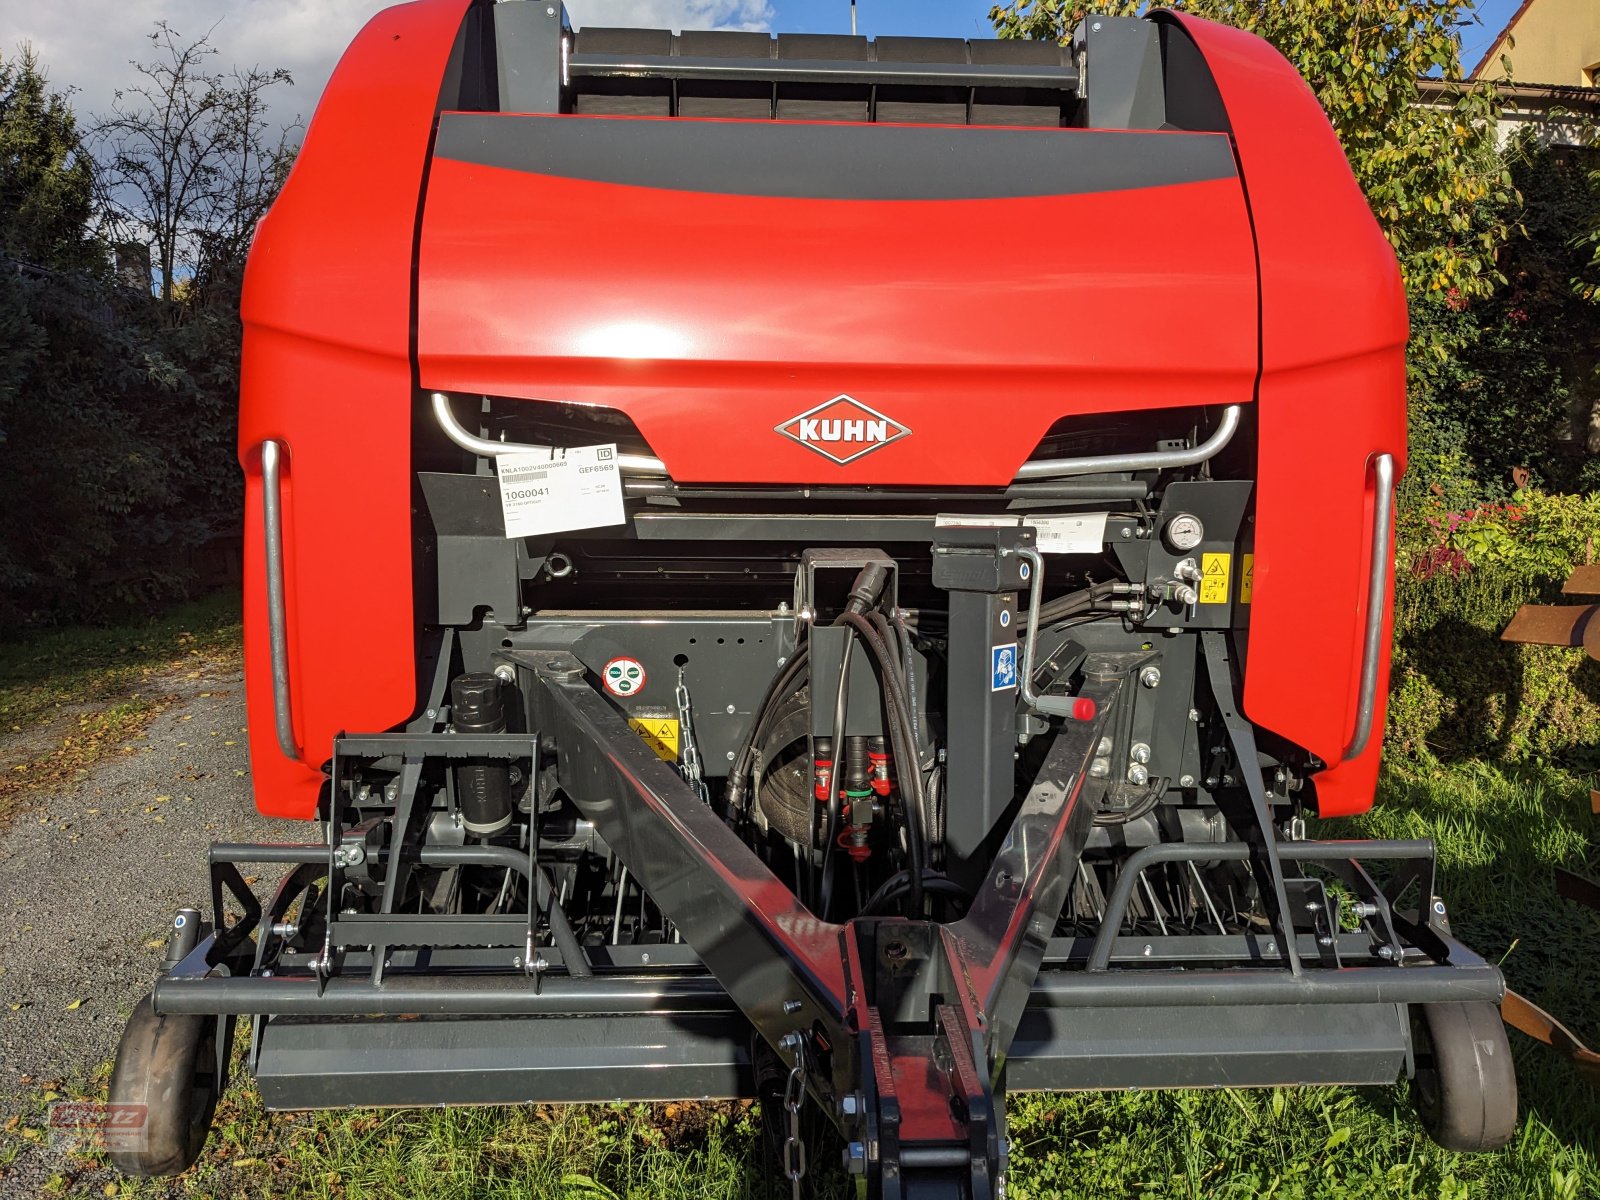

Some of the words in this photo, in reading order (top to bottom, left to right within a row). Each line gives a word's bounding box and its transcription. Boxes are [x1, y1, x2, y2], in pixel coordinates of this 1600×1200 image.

[799, 418, 887, 442] KUHN
[600, 450, 610, 458] ID
[578, 464, 614, 474] GEF6569
[505, 487, 550, 500] 10G0041
